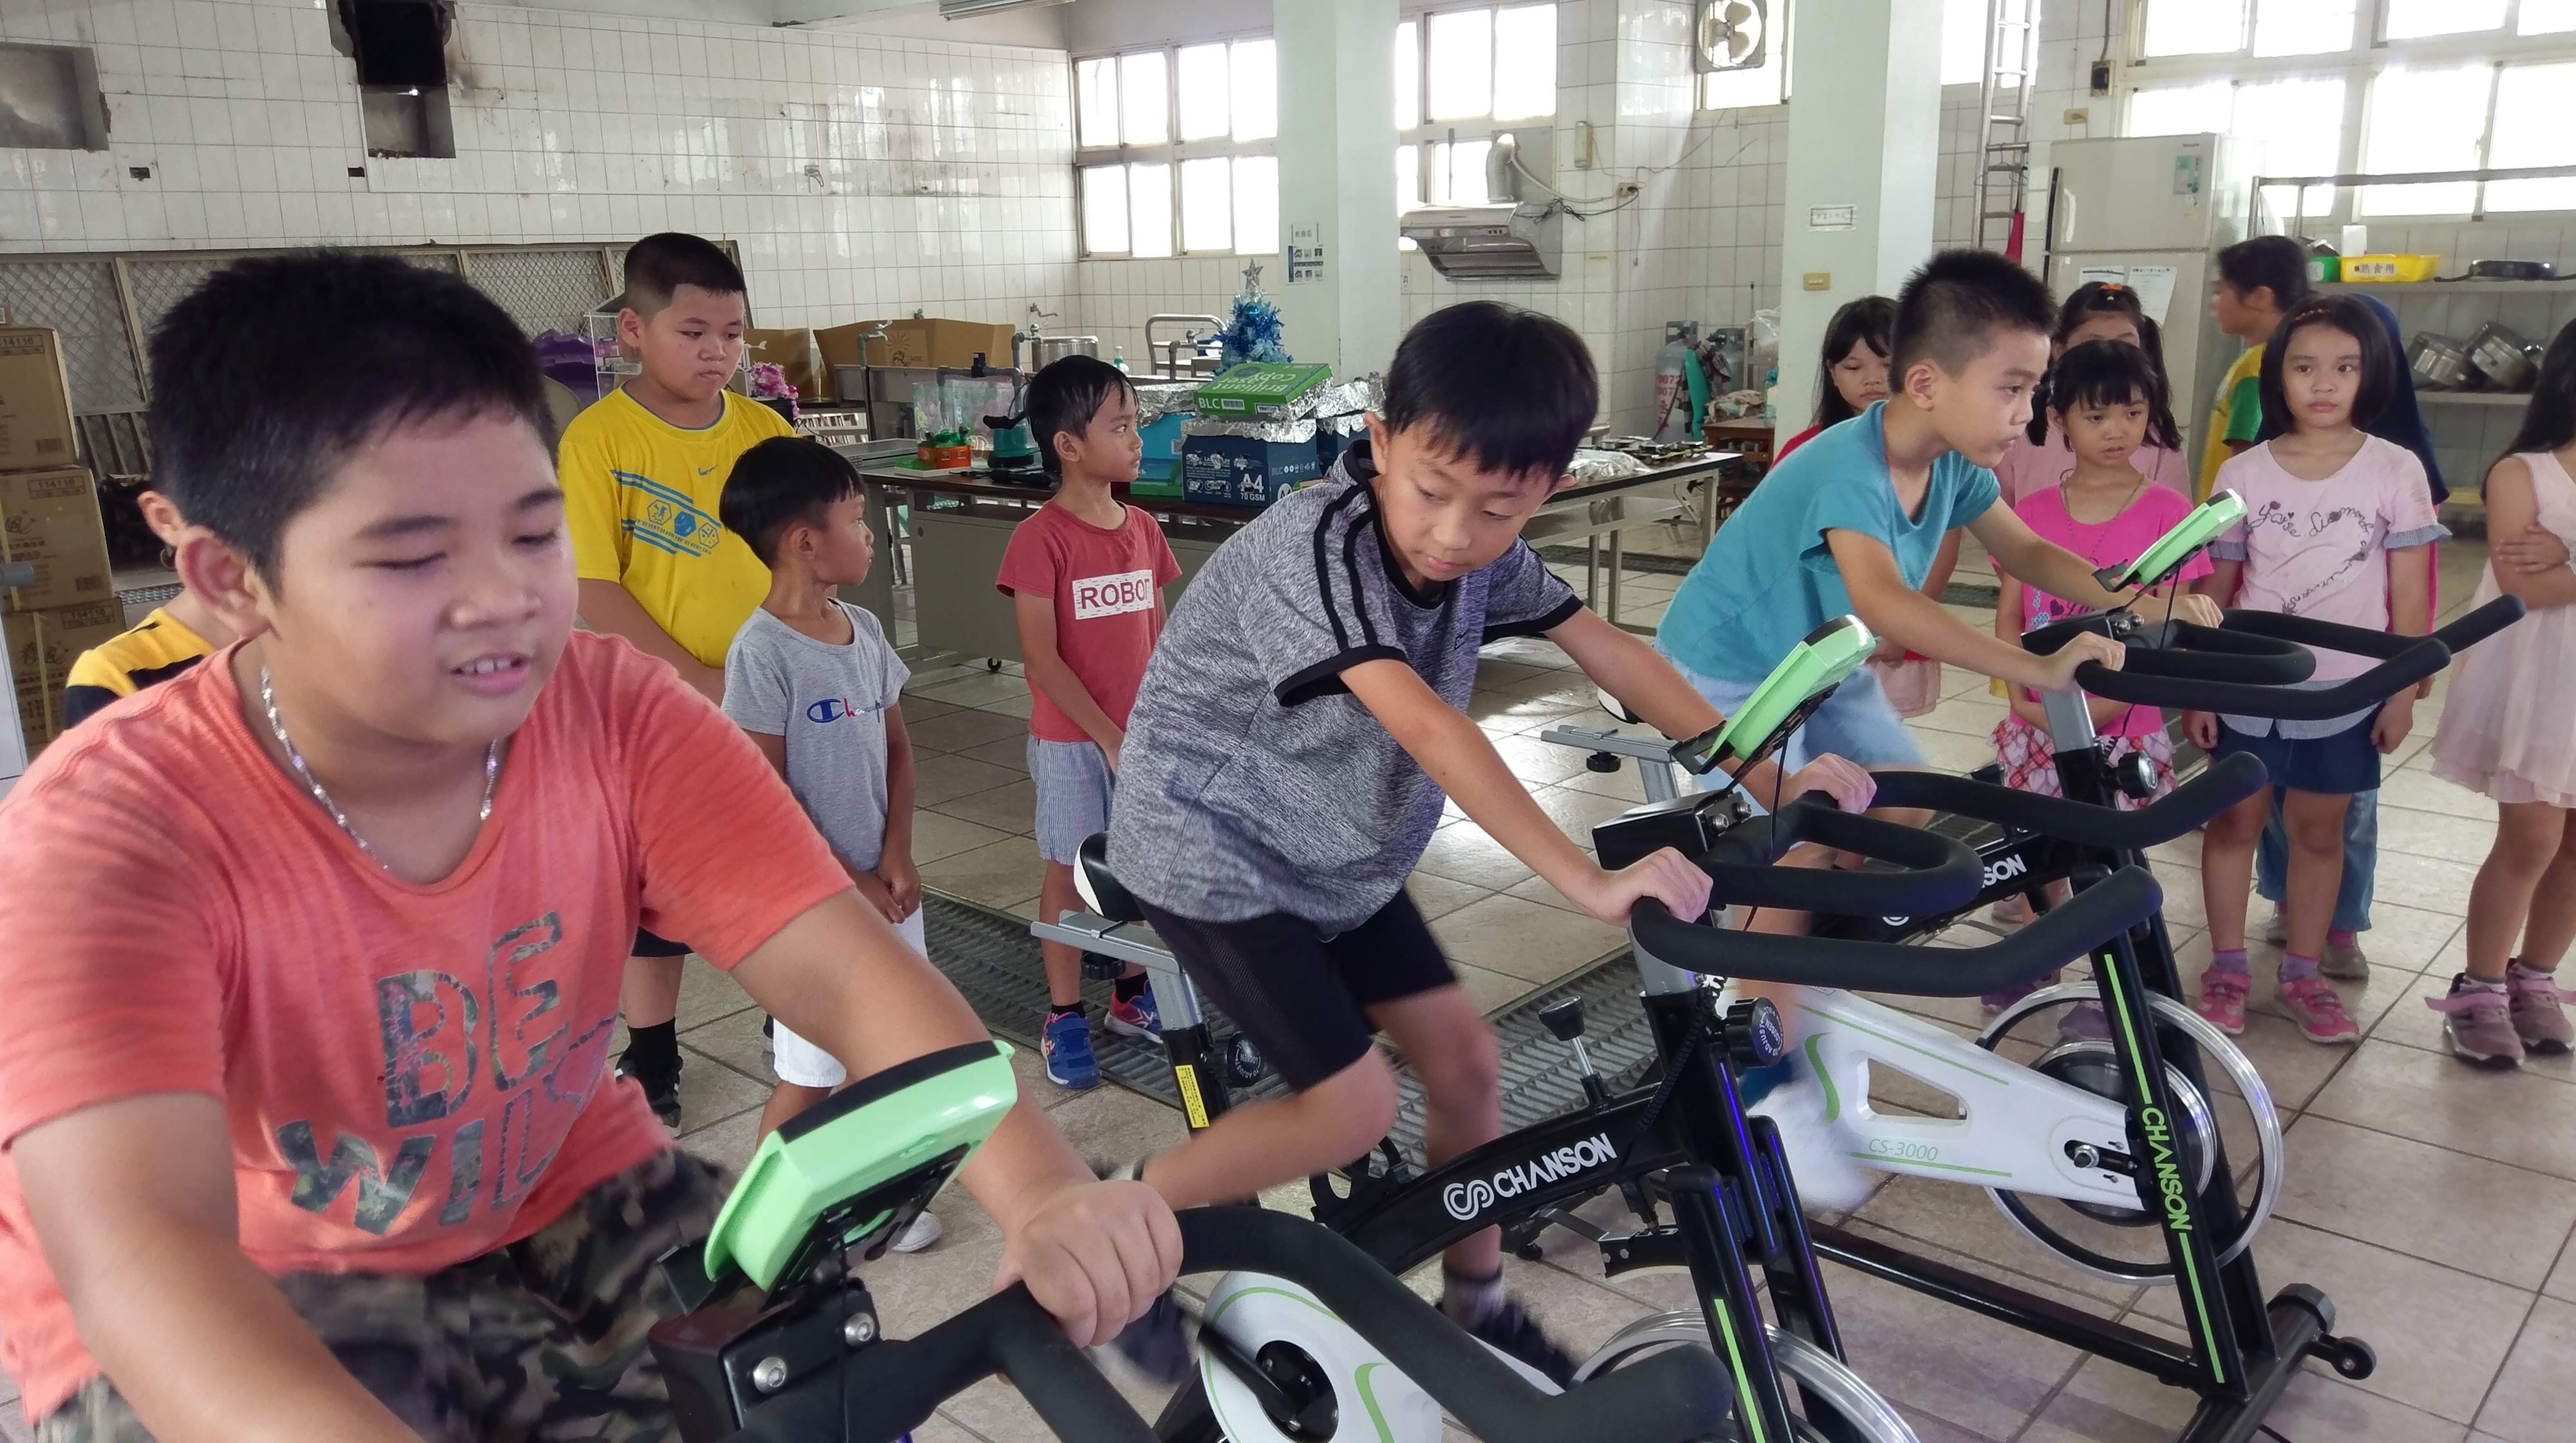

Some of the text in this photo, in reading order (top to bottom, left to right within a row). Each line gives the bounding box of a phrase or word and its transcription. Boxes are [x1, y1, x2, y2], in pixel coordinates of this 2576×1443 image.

[1213, 383, 1286, 392] Brilliant
[1251, 372, 1296, 382] Copy
[1198, 397, 1221, 409] BLC
[1249, 493, 1266, 502] GSM
[1080, 578, 1150, 609] ROBOT
[1982, 854, 2027, 888] SON
[377, 911, 571, 1128] BE
[1869, 1138, 1938, 1161] CS-3000
[1493, 1132, 1618, 1198] CHANSON
[2142, 1107, 2193, 1230] CHANSON
